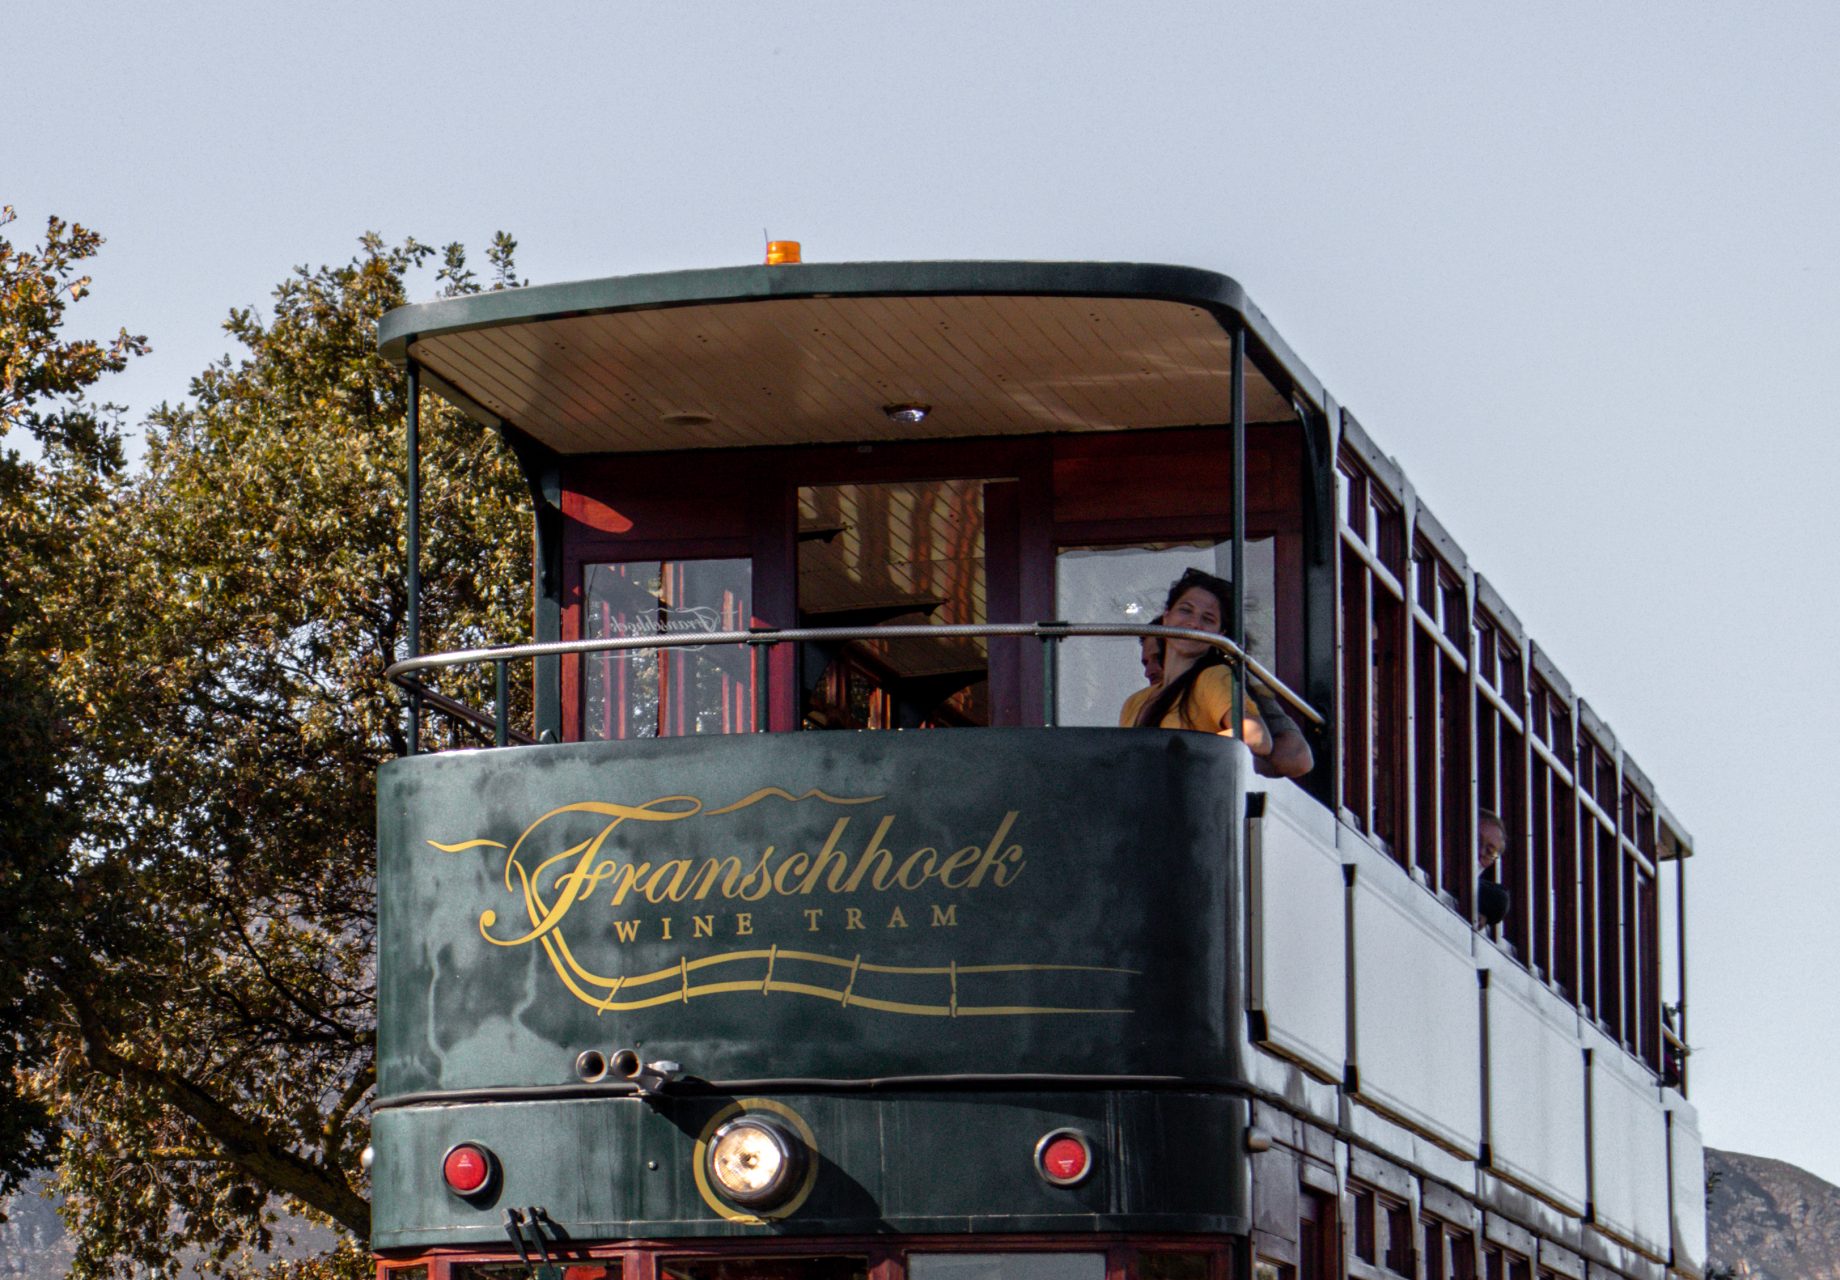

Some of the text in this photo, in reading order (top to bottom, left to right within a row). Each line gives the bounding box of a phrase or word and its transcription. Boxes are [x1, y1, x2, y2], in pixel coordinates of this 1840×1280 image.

[480, 795, 1026, 946] Franschhoek
[614, 895, 959, 943] WINE TRAM
